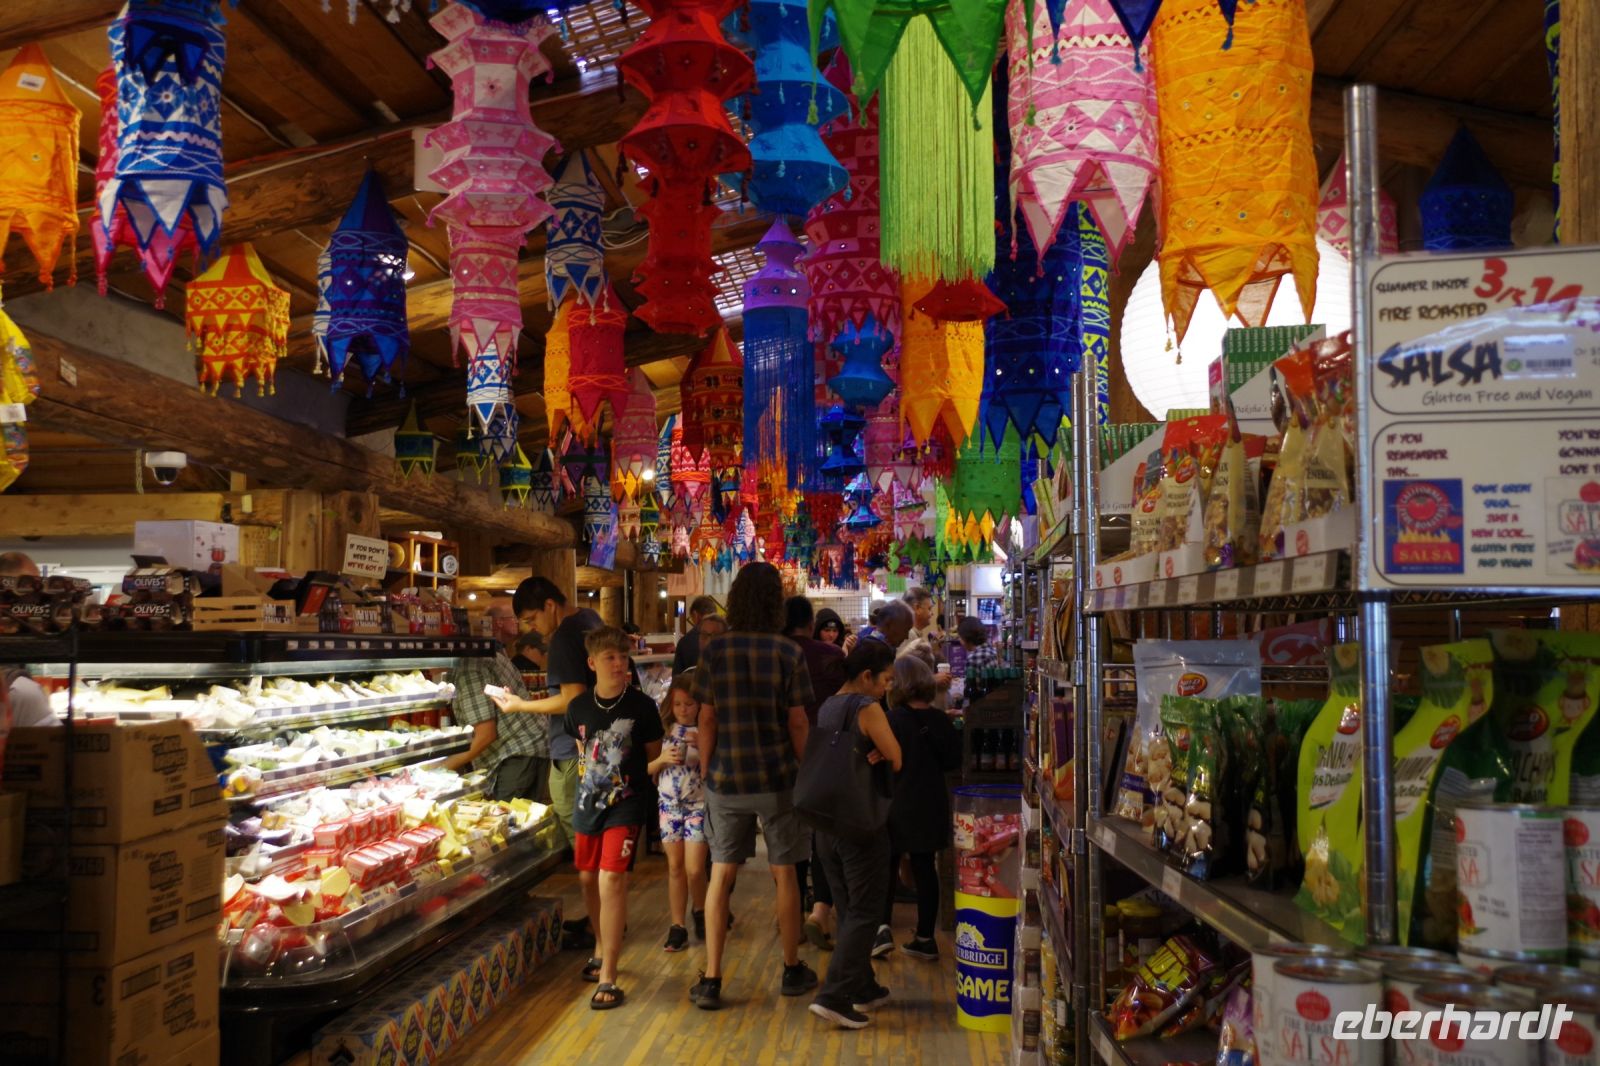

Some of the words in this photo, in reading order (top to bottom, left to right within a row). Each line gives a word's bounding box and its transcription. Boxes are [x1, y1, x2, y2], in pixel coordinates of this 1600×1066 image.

[1376, 281, 1428, 294] SUMMER
[1432, 278, 1470, 290] INSIDE
[1379, 306, 1412, 322] FIRE
[1418, 302, 1488, 320] ROASTED
[1378, 341, 1503, 387] SALSA
[1422, 391, 1472, 406] Gluten
[1475, 391, 1510, 403] Free
[1515, 388, 1541, 402] and
[1545, 389, 1593, 404] Vegan
[1386, 434, 1397, 444] IF
[1400, 433, 1423, 444] YOU
[1386, 449, 1448, 461] REMEMBER
[1560, 464, 1589, 475] LOVE
[1511, 513, 1520, 523] A
[1471, 529, 1494, 538] NEW
[356, 544, 368, 552] YOU
[368, 546, 385, 554] DON'T
[1471, 543, 1507, 553] GLUTEN
[1510, 543, 1535, 553] FREE
[1399, 550, 1453, 561] SALSA
[347, 561, 364, 569] WE'VE
[1478, 558, 1498, 568] AND
[1501, 558, 1533, 568] VEGAN
[134, 577, 162, 586] OLIVES
[11, 605, 45, 614] OLIVES
[134, 605, 165, 614] OLIVES
